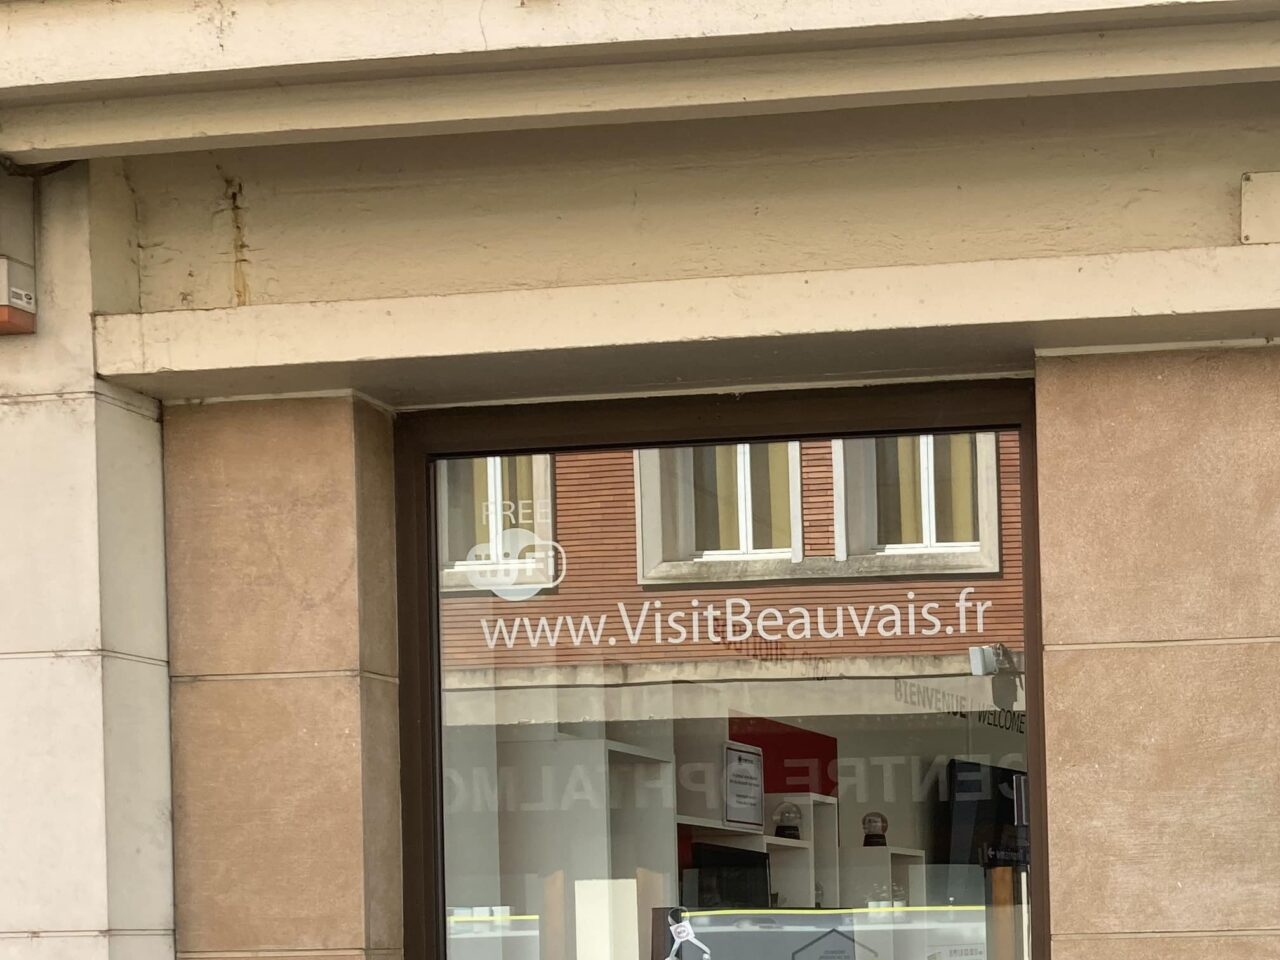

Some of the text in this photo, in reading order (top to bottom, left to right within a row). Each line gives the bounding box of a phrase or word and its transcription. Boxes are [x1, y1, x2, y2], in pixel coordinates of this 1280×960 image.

[481, 499, 551, 525] FREE
[479, 587, 993, 648] www.VisitBeauvais.fr
[894, 677, 967, 719] BIENVENUE
[977, 708, 1025, 734] WELCOME
